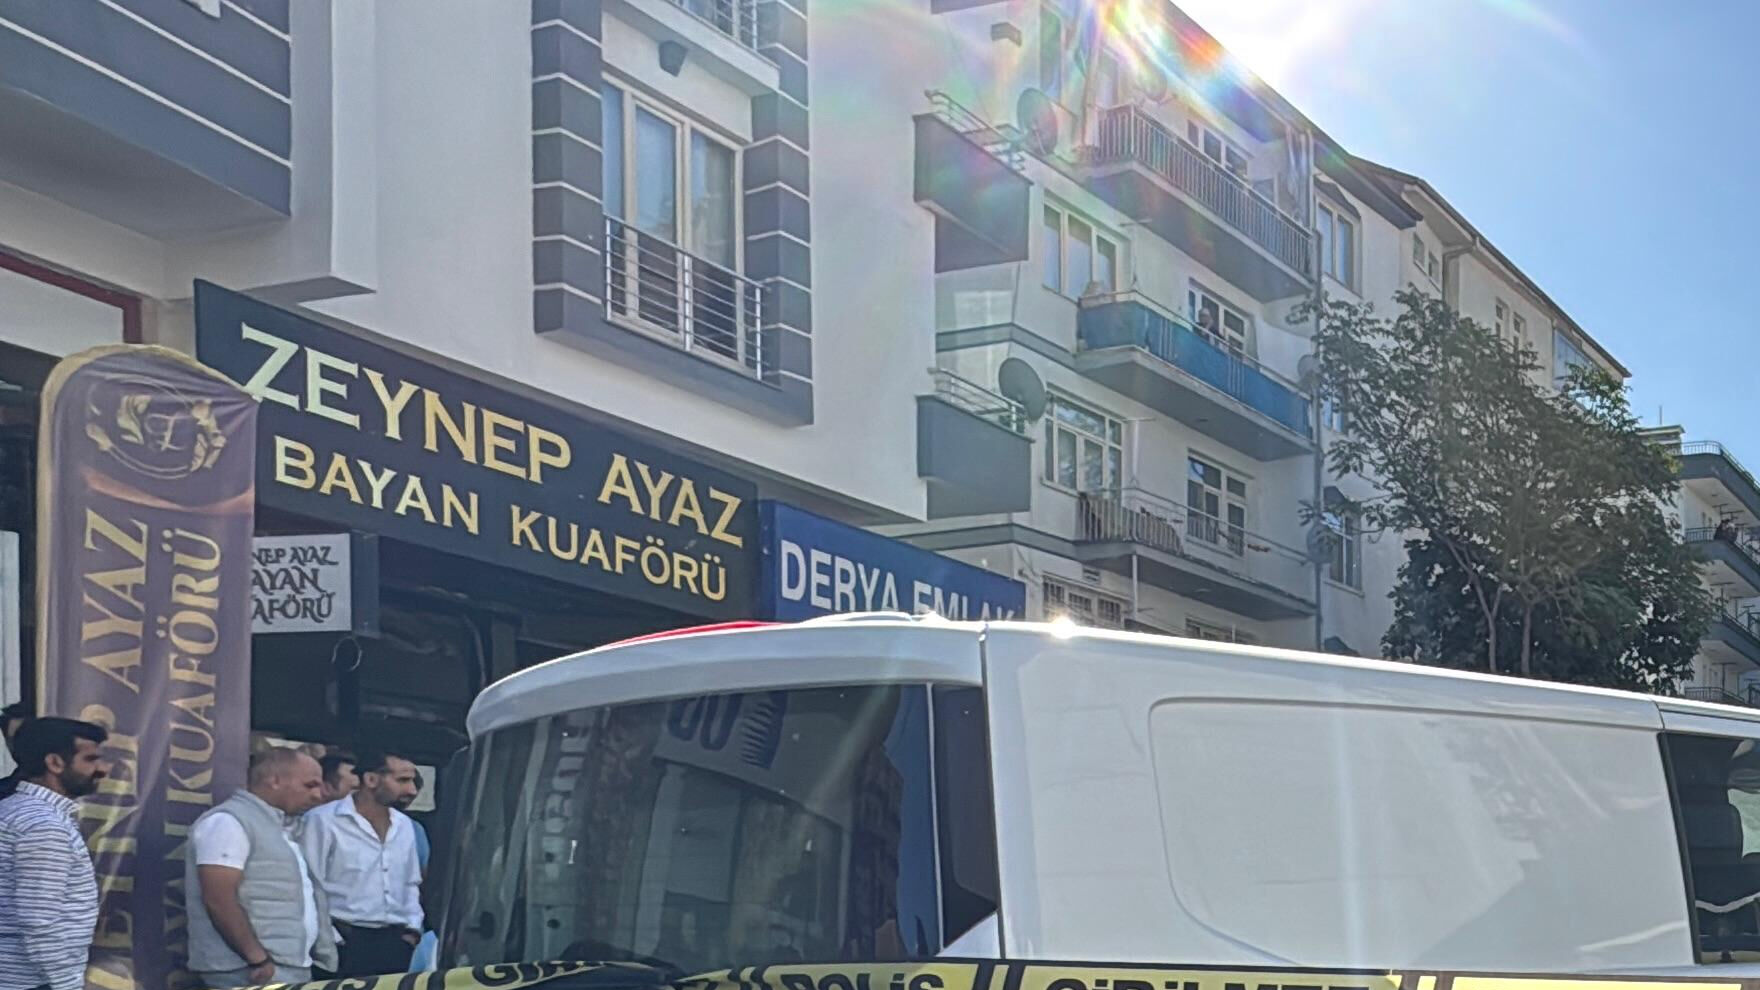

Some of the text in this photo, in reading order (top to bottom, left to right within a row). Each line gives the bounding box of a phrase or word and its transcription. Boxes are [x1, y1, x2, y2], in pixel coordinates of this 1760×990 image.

[241, 322, 744, 549] ZEYNEP AYAZ
[252, 545, 339, 567] NEP AYAZ
[273, 434, 727, 601] BAYAN KUAFÖRÜ
[781, 540, 900, 612] DERYA
[81, 508, 148, 694] AYAZ
[250, 591, 336, 625] AFÖRÜ
[252, 565, 327, 596] AYAN
[157, 527, 222, 806] KUAFÖRÜ
